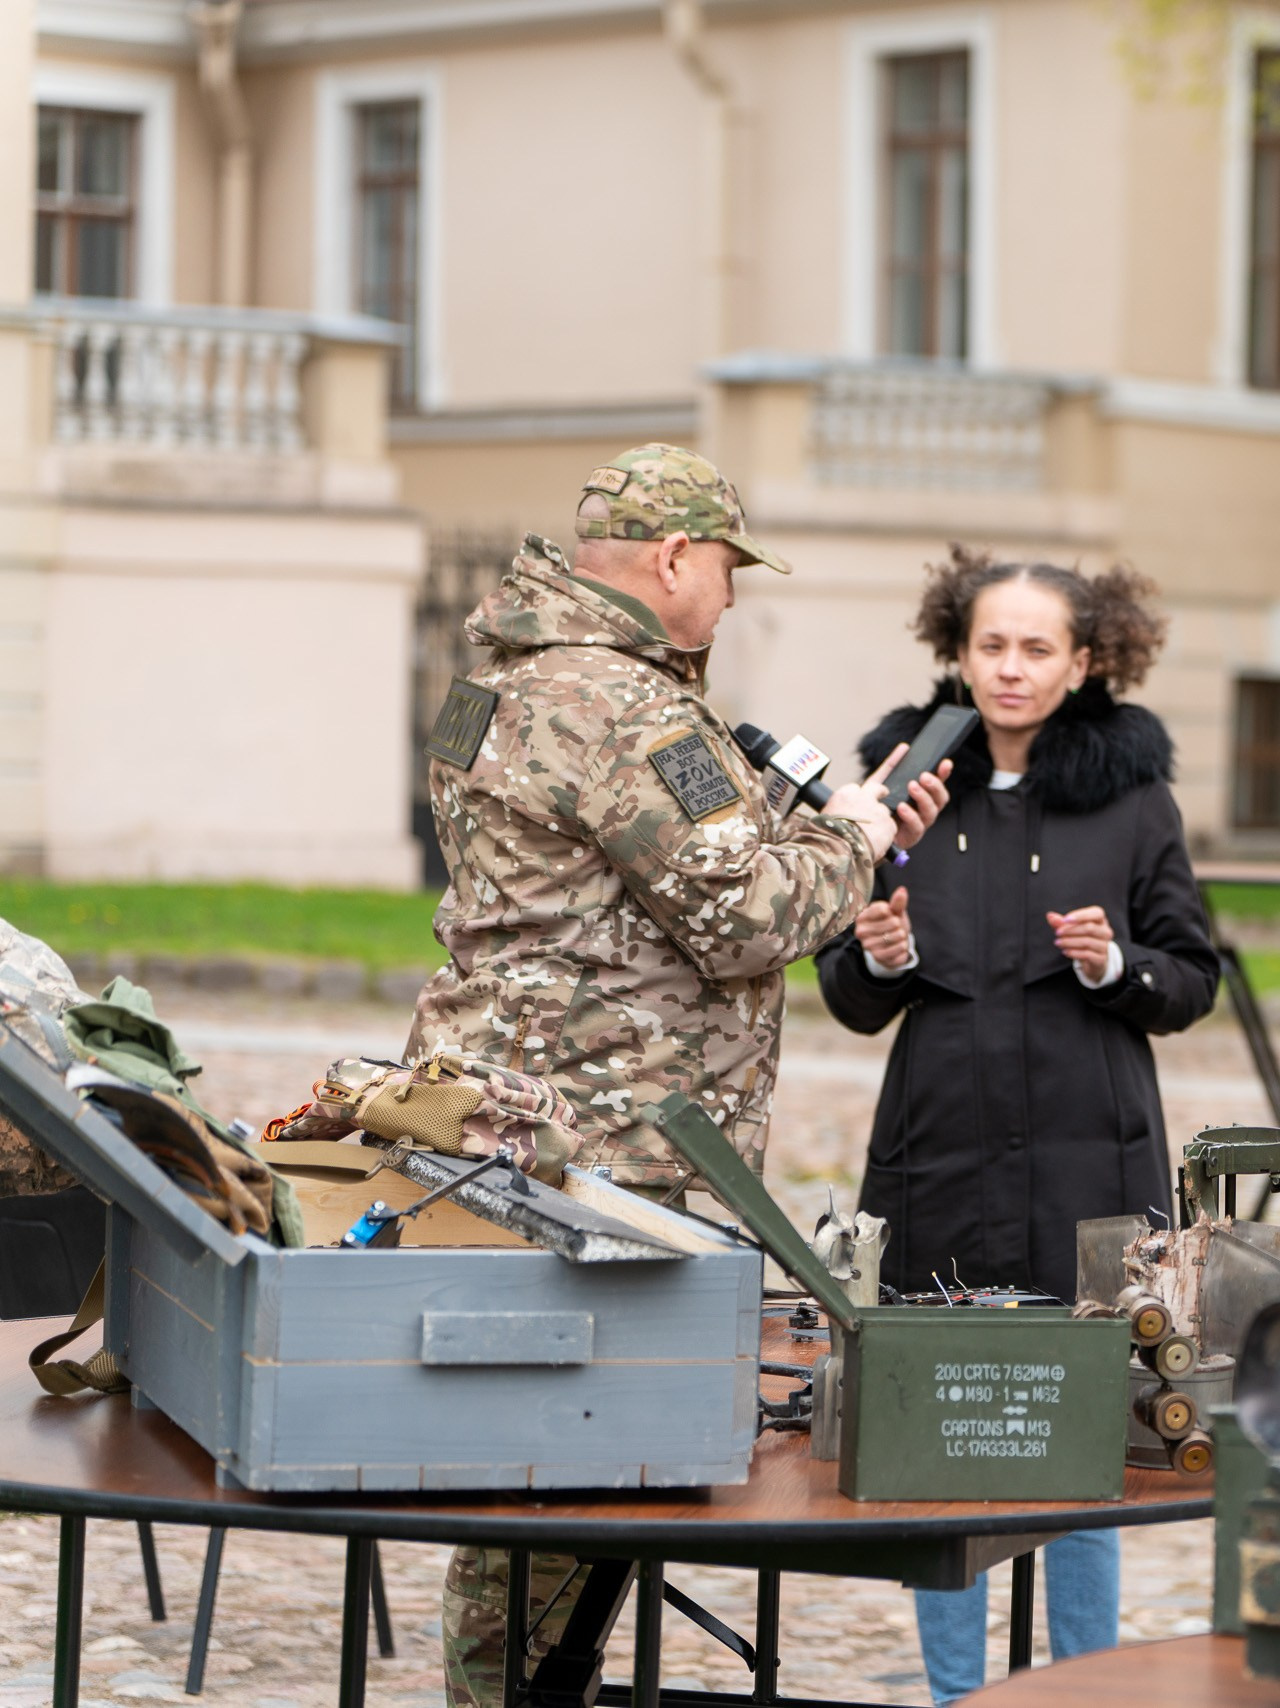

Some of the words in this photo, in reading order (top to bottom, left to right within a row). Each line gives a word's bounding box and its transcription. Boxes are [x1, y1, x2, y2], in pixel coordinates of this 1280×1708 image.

[657, 752, 676, 765] НА
[674, 738, 703, 757] НЕБЕ
[677, 754, 697, 769] БОГ
[675, 758, 715, 790] ZOV
[682, 789, 699, 801] НА
[696, 775, 727, 795] ЗЕМЛЕ
[694, 787, 730, 808] РОССИЯ
[934, 1363, 962, 1381] 200
[963, 1363, 1001, 1381] CRTG
[1002, 1363, 1050, 1381] 7.62MM
[935, 1385, 946, 1402] 4
[1003, 1385, 1010, 1402] 1
[941, 1419, 1005, 1437] CARTONS
[1026, 1419, 1052, 1437] M13
